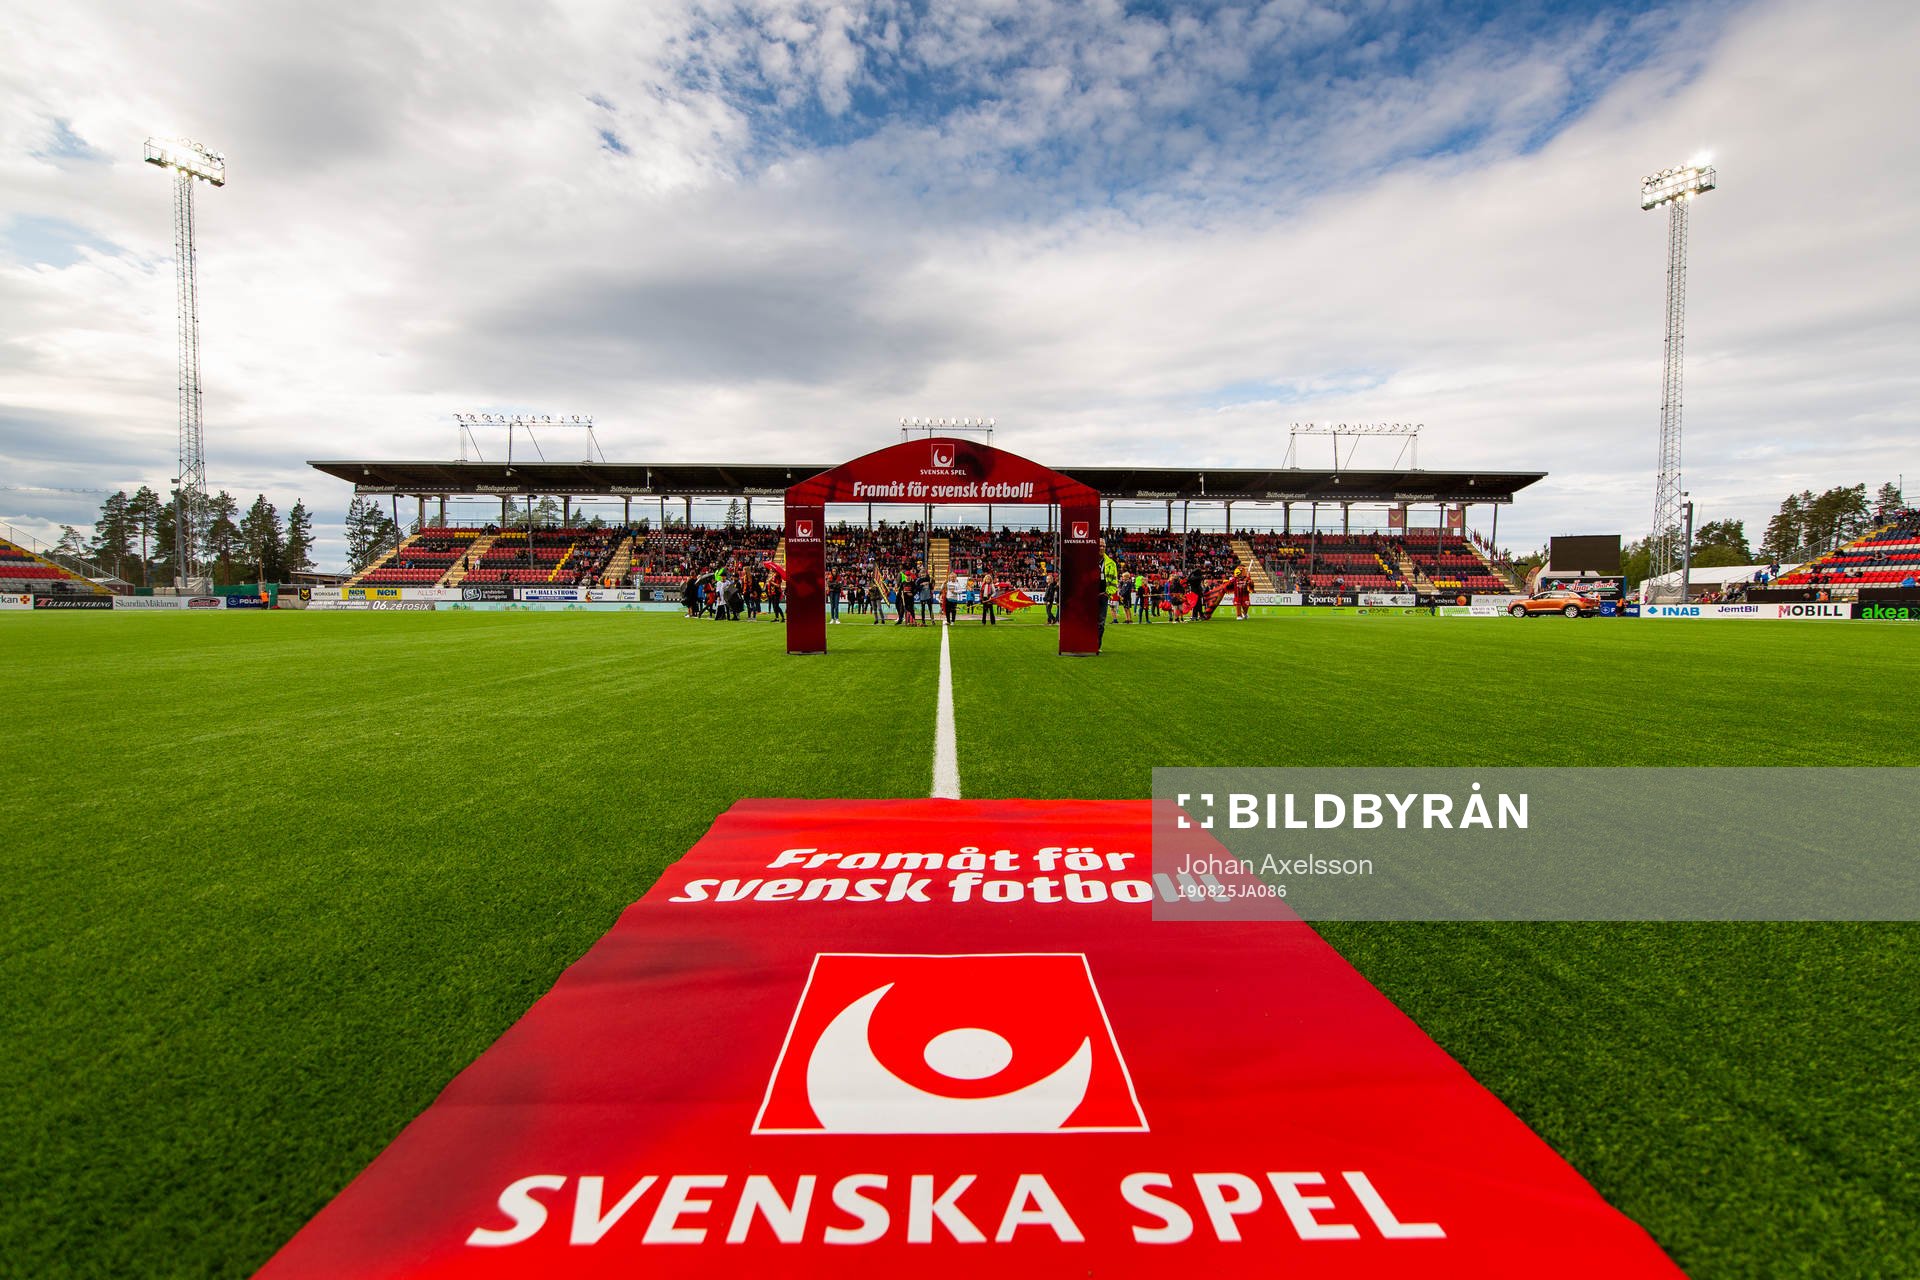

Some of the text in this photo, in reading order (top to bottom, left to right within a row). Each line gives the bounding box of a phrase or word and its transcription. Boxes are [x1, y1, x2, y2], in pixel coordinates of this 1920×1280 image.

[853, 480, 1034, 498] Framåt för svensk fotboll!
[115, 600, 178, 608] SkandiaMäklarna
[1662, 607, 1700, 616] INAB
[1717, 605, 1759, 613] JemtBil
[1778, 605, 1843, 618] MOBILL
[1862, 603, 1909, 619] akea
[766, 846, 1136, 871] Framåt för
[669, 872, 932, 903] svensk
[465, 1171, 1448, 1247] SVENSKA SPEL
